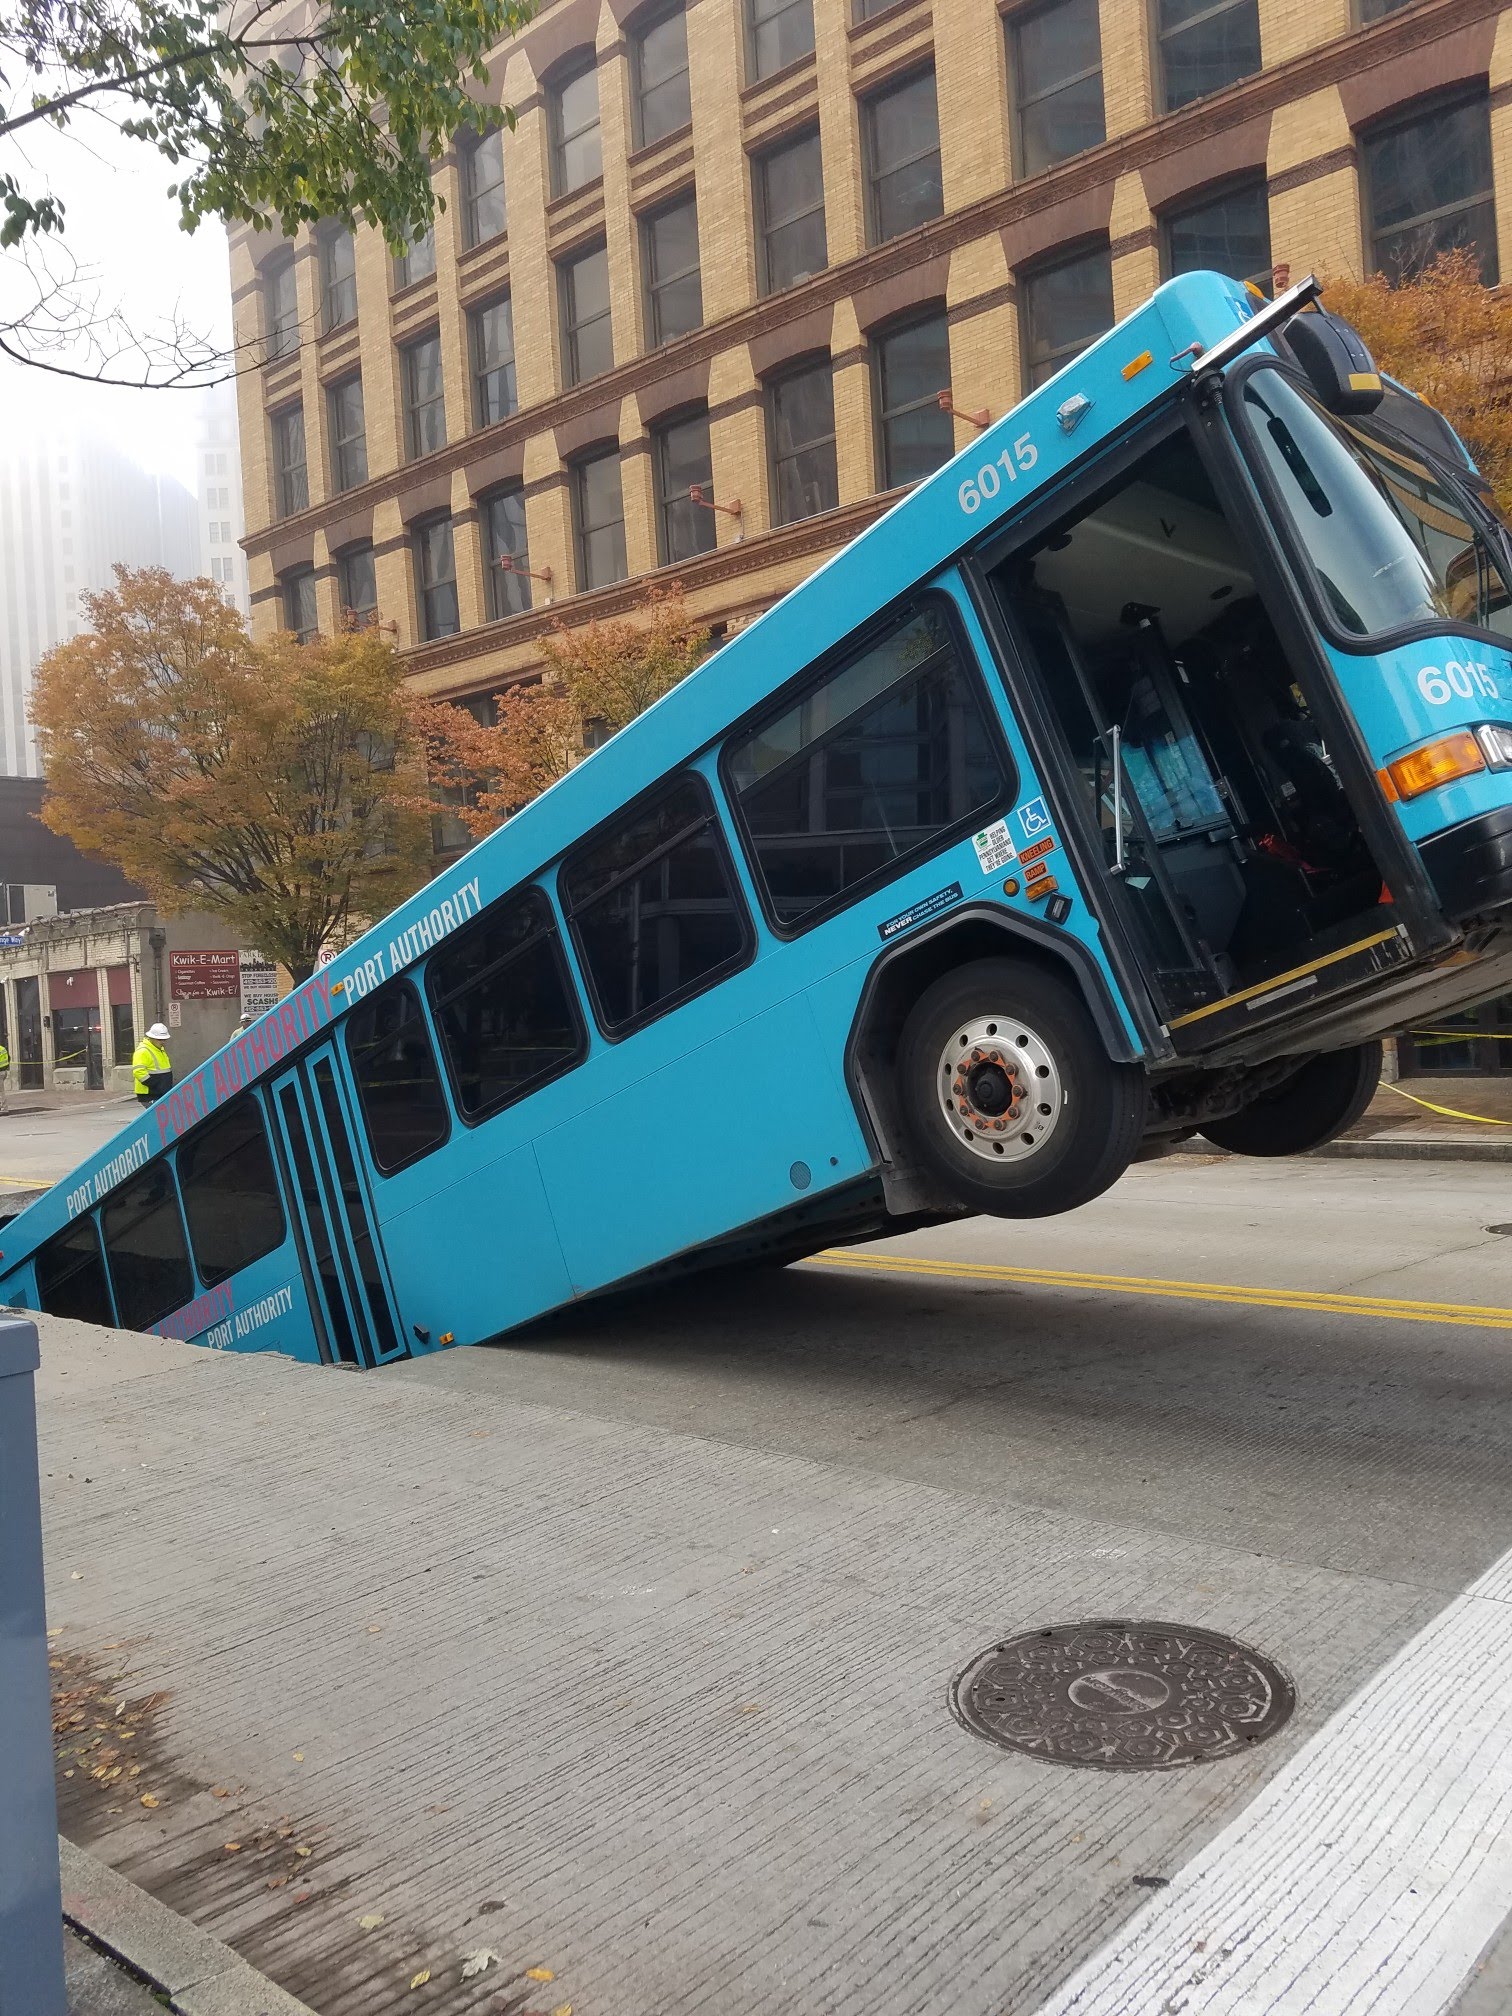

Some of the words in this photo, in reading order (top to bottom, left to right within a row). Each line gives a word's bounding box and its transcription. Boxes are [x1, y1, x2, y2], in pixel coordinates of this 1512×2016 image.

[957, 432, 1039, 515] 6015
[1417, 661, 1499, 705] 6015
[1020, 839, 1053, 863] KNEELING
[1025, 864, 1045, 880] RAMP
[884, 916, 913, 935] NEVER
[912, 906, 933, 920] CHASE
[932, 899, 946, 909] THE
[945, 892, 959, 903] BUS
[898, 911, 915, 921] YOUR
[914, 902, 929, 913] OWN
[173, 954, 236, 965] Kwik-E-Mart
[342, 950, 388, 1006] PORT
[389, 876, 483, 975] AUTHORITY
[154, 1077, 209, 1148] PORT
[212, 972, 335, 1106] AUTHORITY
[66, 1179, 94, 1220] PORT
[93, 1133, 151, 1198] AUTHORITY
[207, 1320, 234, 1350] PORT
[235, 1285, 293, 1339] AUTHORITY
